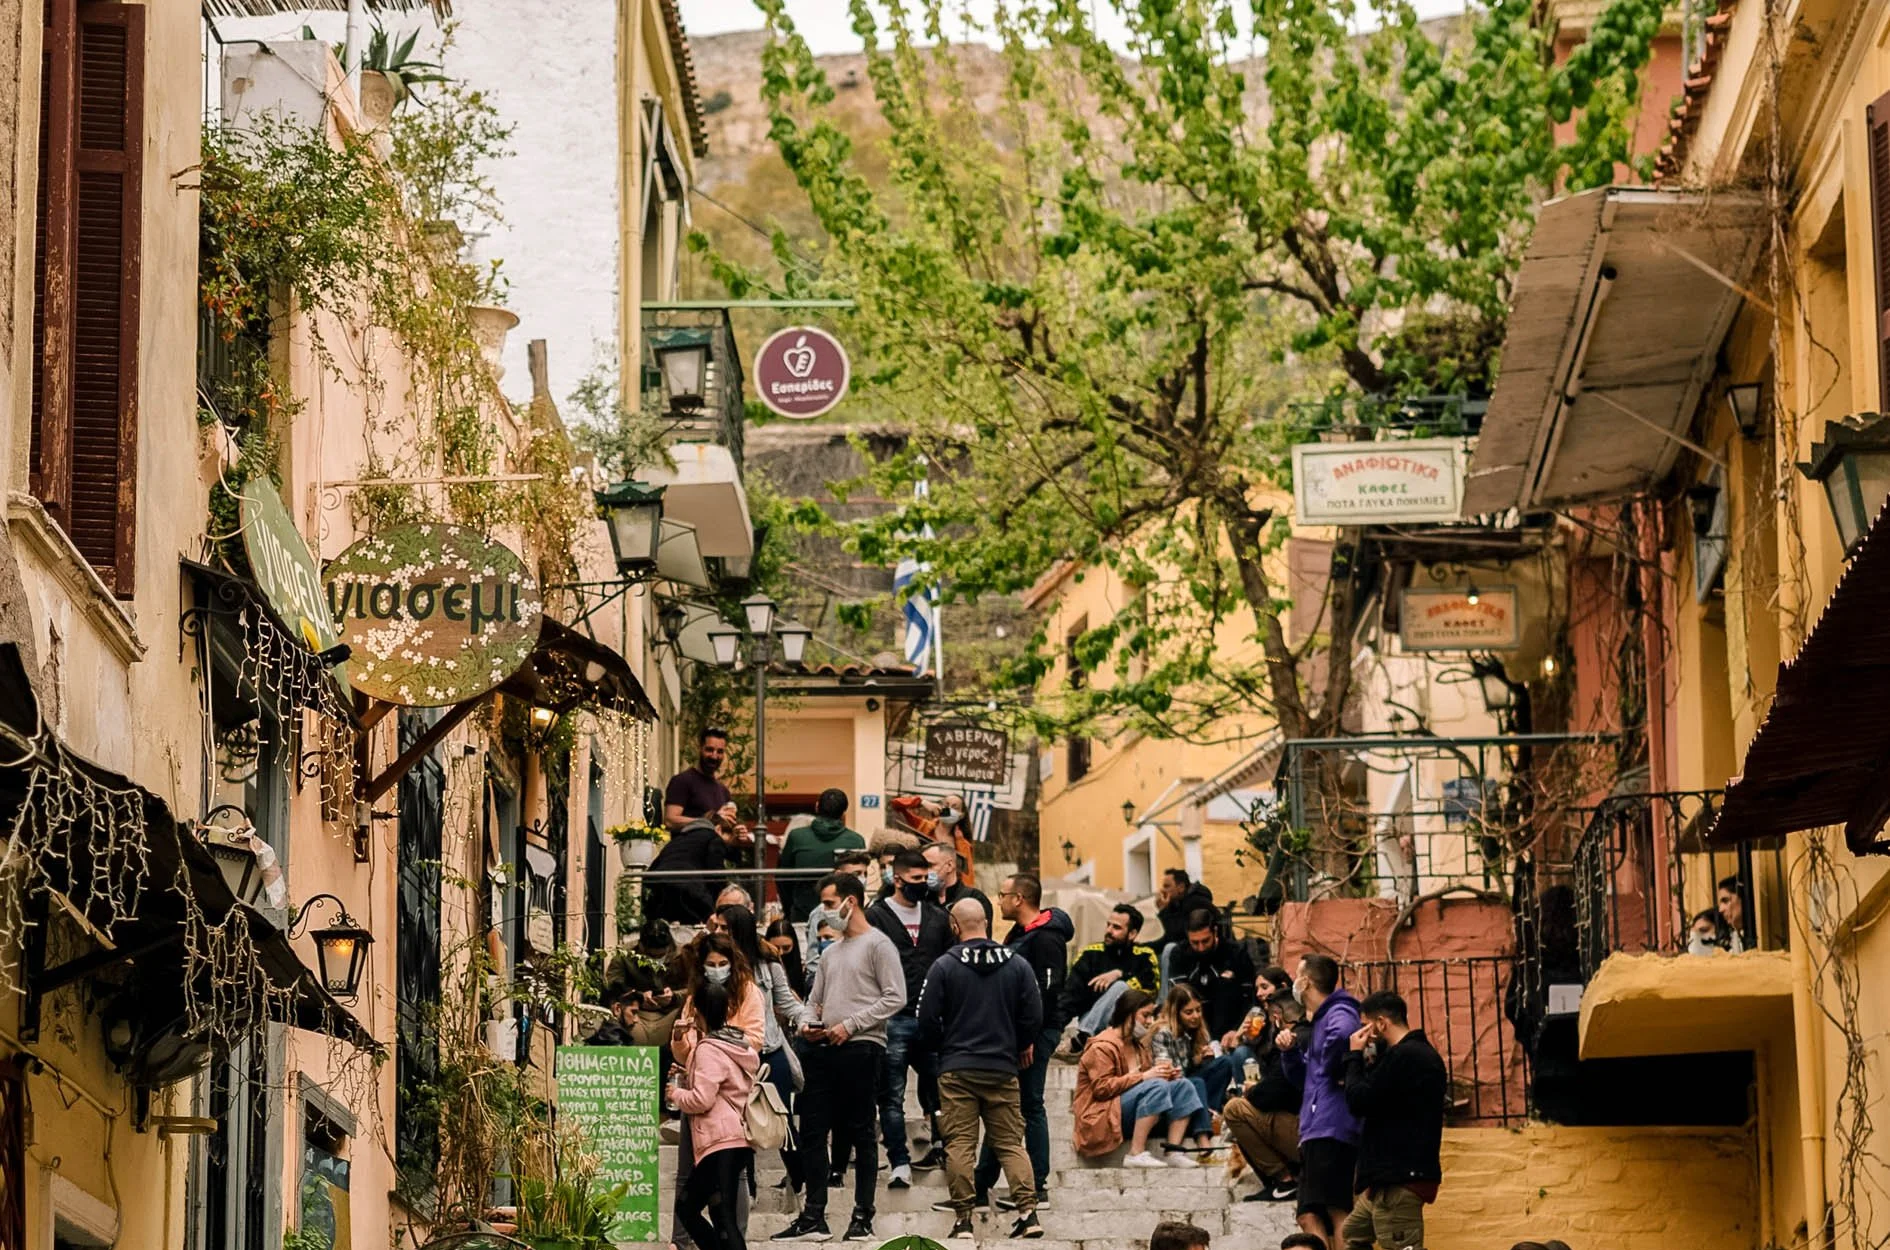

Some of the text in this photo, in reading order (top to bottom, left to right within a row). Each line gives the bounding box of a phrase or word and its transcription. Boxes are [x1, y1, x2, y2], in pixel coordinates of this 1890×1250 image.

[1333, 457, 1440, 481] ΑΝΑΦΙΩΤΙΚΑ
[933, 729, 1004, 750] ΤΑΒΕΡΝΑ
[863, 796, 877, 806] 27
